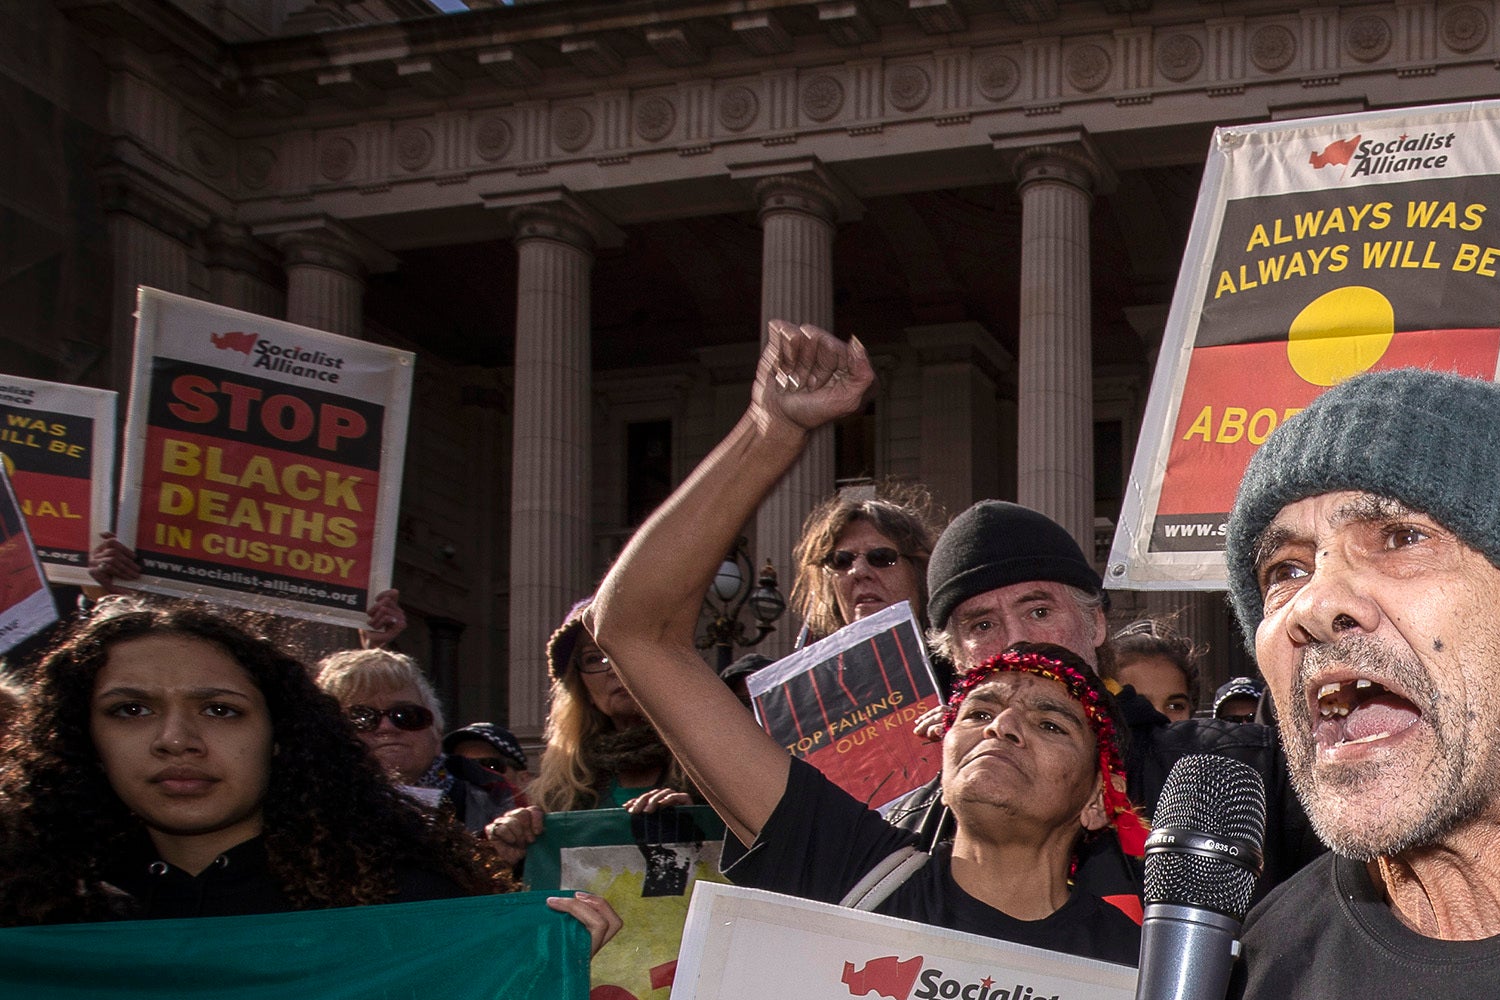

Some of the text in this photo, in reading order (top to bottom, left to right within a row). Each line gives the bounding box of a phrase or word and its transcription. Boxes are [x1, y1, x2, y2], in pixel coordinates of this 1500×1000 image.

[1351, 153, 1448, 177] Alliance
[1354, 132, 1456, 161] Socialist
[1246, 201, 1487, 252] ALWAYS WAS
[1214, 244, 1350, 299] ALWAYS
[1363, 241, 1441, 269] WILL
[253, 355, 340, 384] Alliance
[254, 339, 345, 370] Socialist
[7, 414, 68, 437] WAS
[167, 374, 368, 451] STOP
[0, 429, 86, 458] ILL BE
[161, 438, 364, 512] BLACK
[158, 481, 358, 548] DEATHS
[155, 523, 357, 578] IN CUSTODY
[143, 559, 358, 606] www.socialist-alliance.org
[786, 691, 904, 757] TOP FAILING
[836, 701, 930, 754] OUR KIDS
